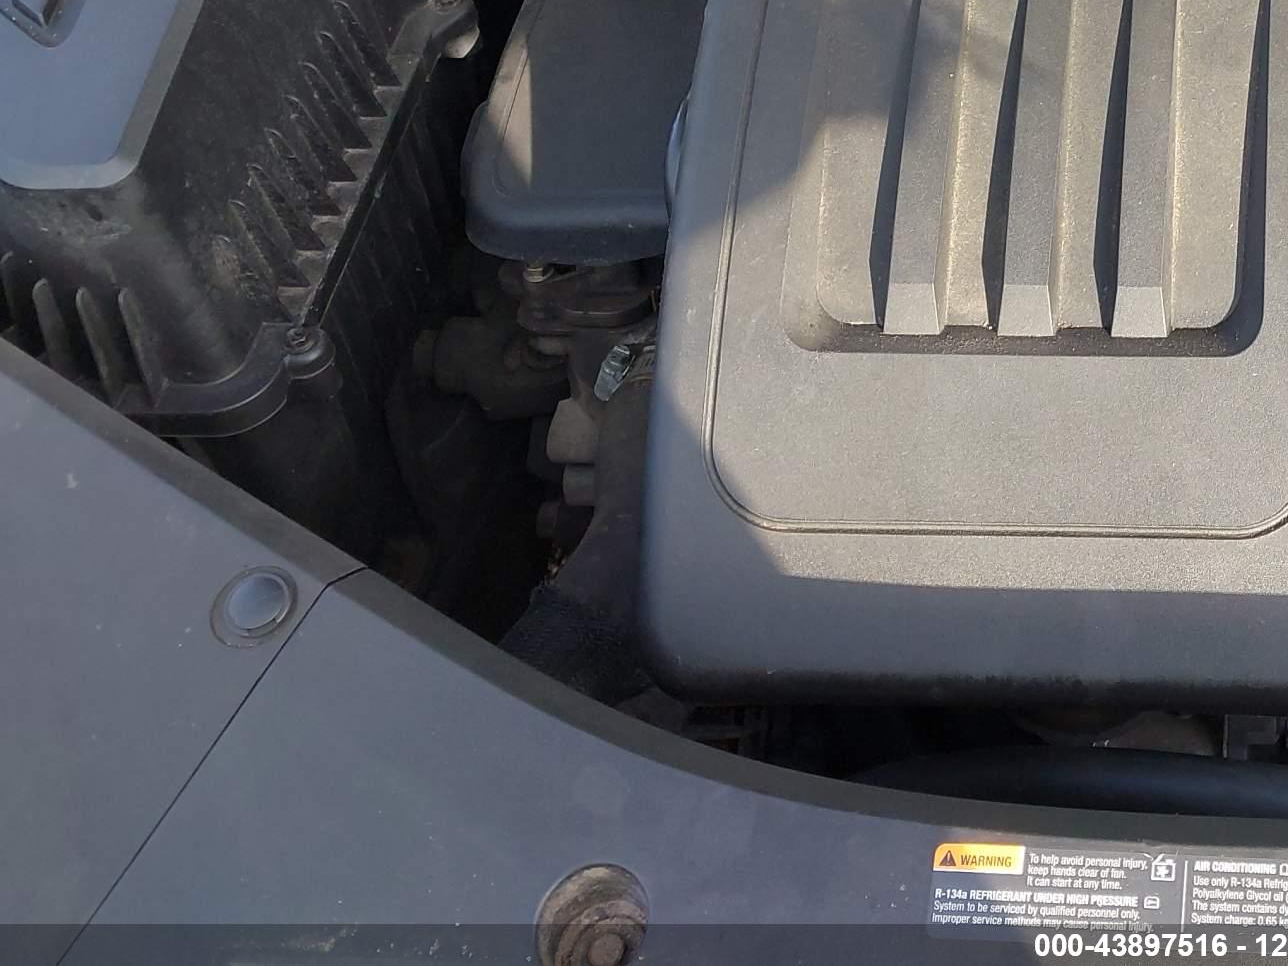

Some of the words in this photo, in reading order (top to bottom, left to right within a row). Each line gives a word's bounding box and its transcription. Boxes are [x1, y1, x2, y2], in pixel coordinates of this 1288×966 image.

[960, 854, 1012, 868] WARNING
[1030, 854, 1039, 864] To
[1041, 855, 1059, 866] help
[1061, 856, 1084, 866] avoid
[1085, 857, 1120, 868] personal
[1122, 858, 1148, 870] injury.
[1194, 860, 1210, 872] AIR
[1212, 862, 1276, 875] CONDITIONING
[1028, 864, 1048, 876] keep
[1050, 866, 1076, 876] hands
[1078, 868, 1099, 877] clear
[1100, 868, 1109, 878] of
[1111, 869, 1126, 878] fan.
[1027, 876, 1033, 886] It
[1034, 878, 1050, 886] can
[1052, 879, 1072, 888] start
[1073, 880, 1082, 888] at
[1084, 880, 1100, 890] any
[1101, 880, 1122, 890] time.
[1194, 876, 1210, 886] Use
[1211, 877, 1228, 889] only
[1230, 878, 1262, 888] R-134a
[934, 888, 968, 900] R-134a
[970, 890, 1032, 902] REFRIGERANT
[1033, 892, 1064, 904] UNDER
[1066, 894, 1090, 904] HIGH
[1090, 894, 1138, 906] PRESSURE
[1192, 888, 1244, 902] Polyalkylene
[1246, 890, 1272, 902] Glycol
[1274, 892, 1284, 902] oil
[934, 900, 964, 912] System
[967, 902, 975, 912] to
[978, 902, 988, 912] be
[990, 904, 1026, 914] serviced
[1028, 904, 1038, 916] by
[1040, 906, 1076, 918] qualified
[1078, 908, 1120, 919] personnel
[1121, 910, 1140, 921] only.
[1192, 900, 1208, 910] The
[1210, 902, 1240, 915] system
[1242, 904, 1278, 914] contains
[932, 913, 970, 924] Improper
[972, 915, 1002, 925] service
[1004, 916, 1041, 927] methods
[1043, 920, 1061, 930] may
[1062, 920, 1088, 929] cause
[1090, 921, 1126, 932] personal
[1192, 913, 1222, 924] System
[1258, 916, 1278, 926] 0.65
